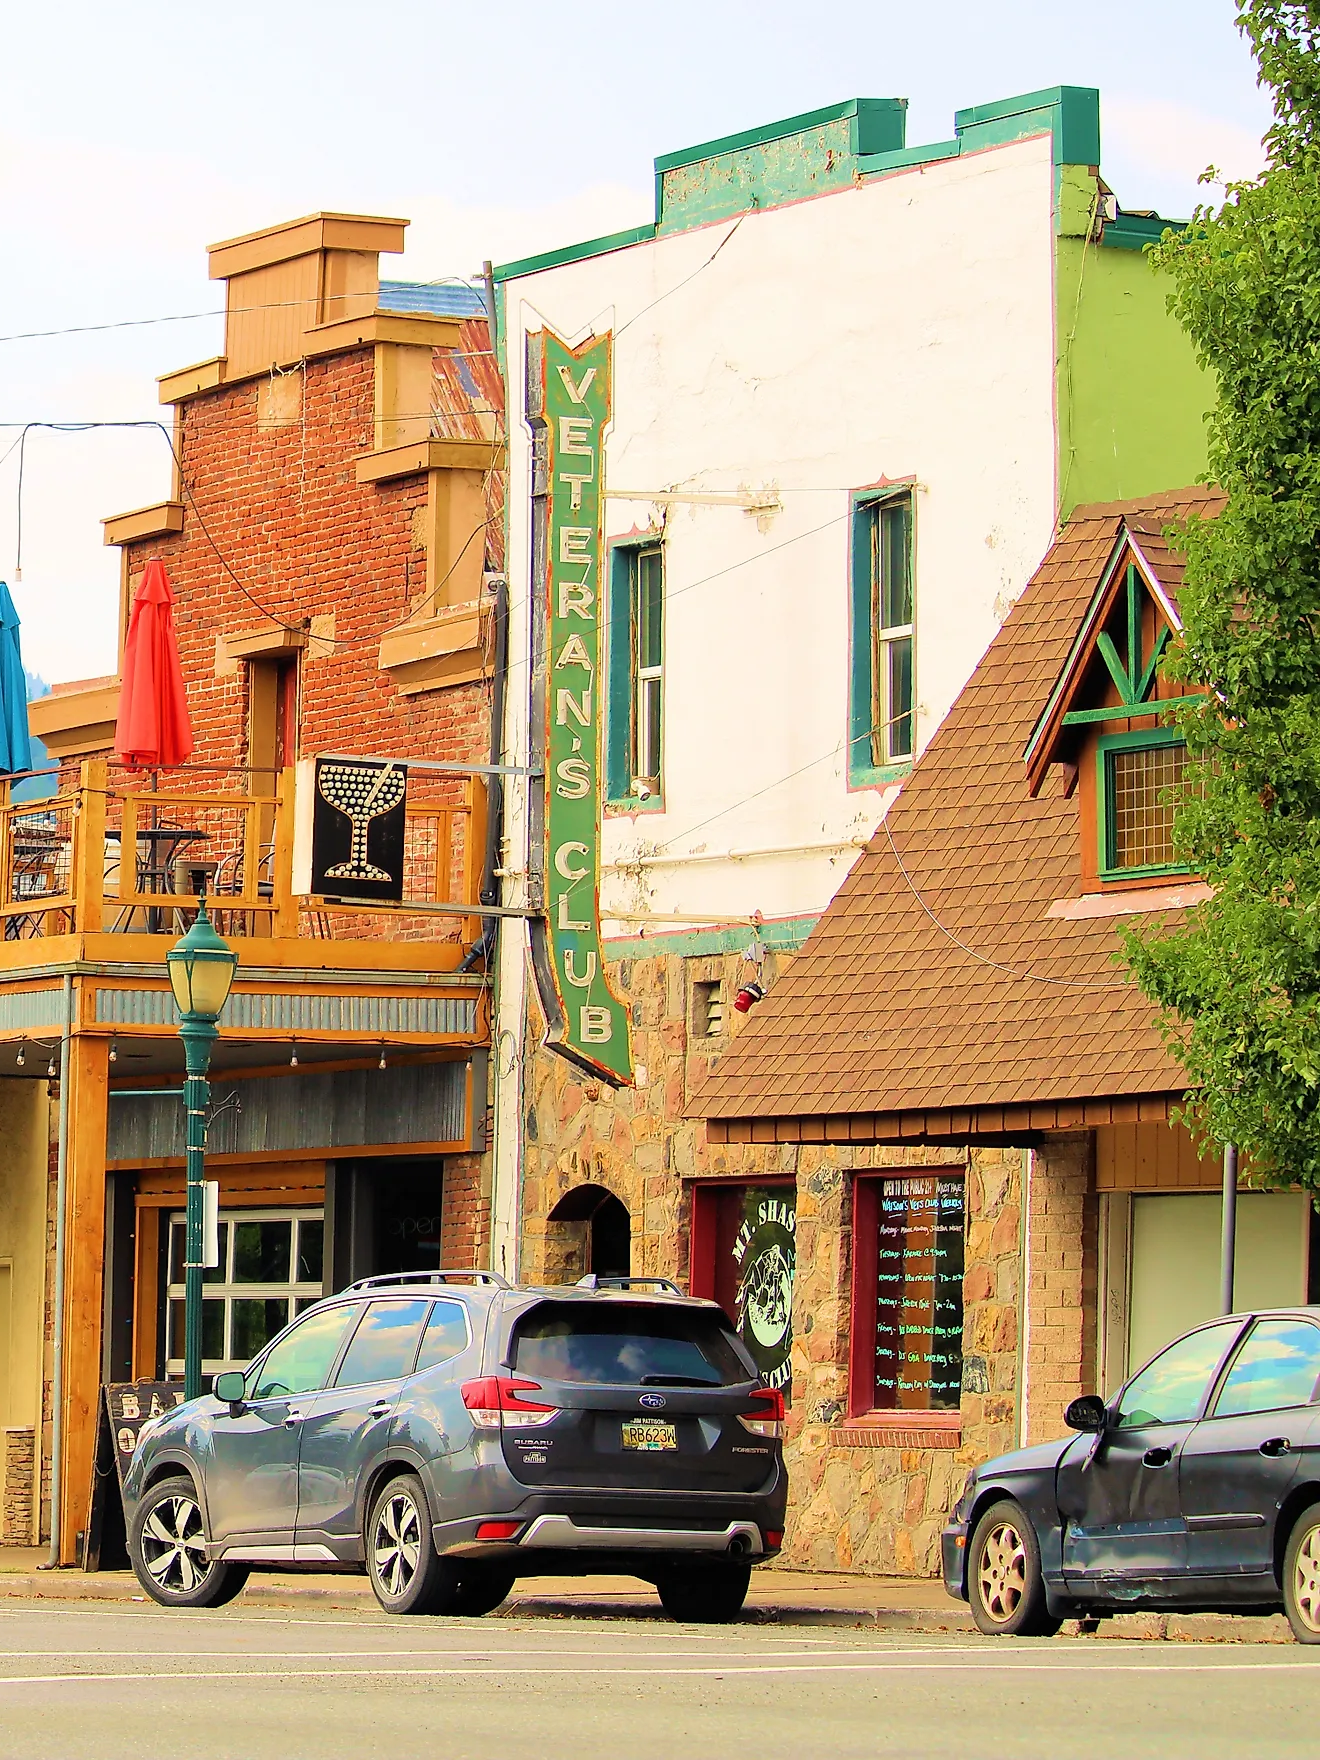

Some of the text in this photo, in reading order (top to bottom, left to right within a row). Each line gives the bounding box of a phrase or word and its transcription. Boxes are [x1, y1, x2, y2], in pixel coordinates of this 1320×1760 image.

[554, 366, 613, 1043] VETERAN'S CLUB
[732, 1219, 756, 1265] MT.
[758, 1199, 796, 1243] SHAS
[770, 1354, 791, 1389] CLU
[629, 1427, 676, 1444] RB623W
